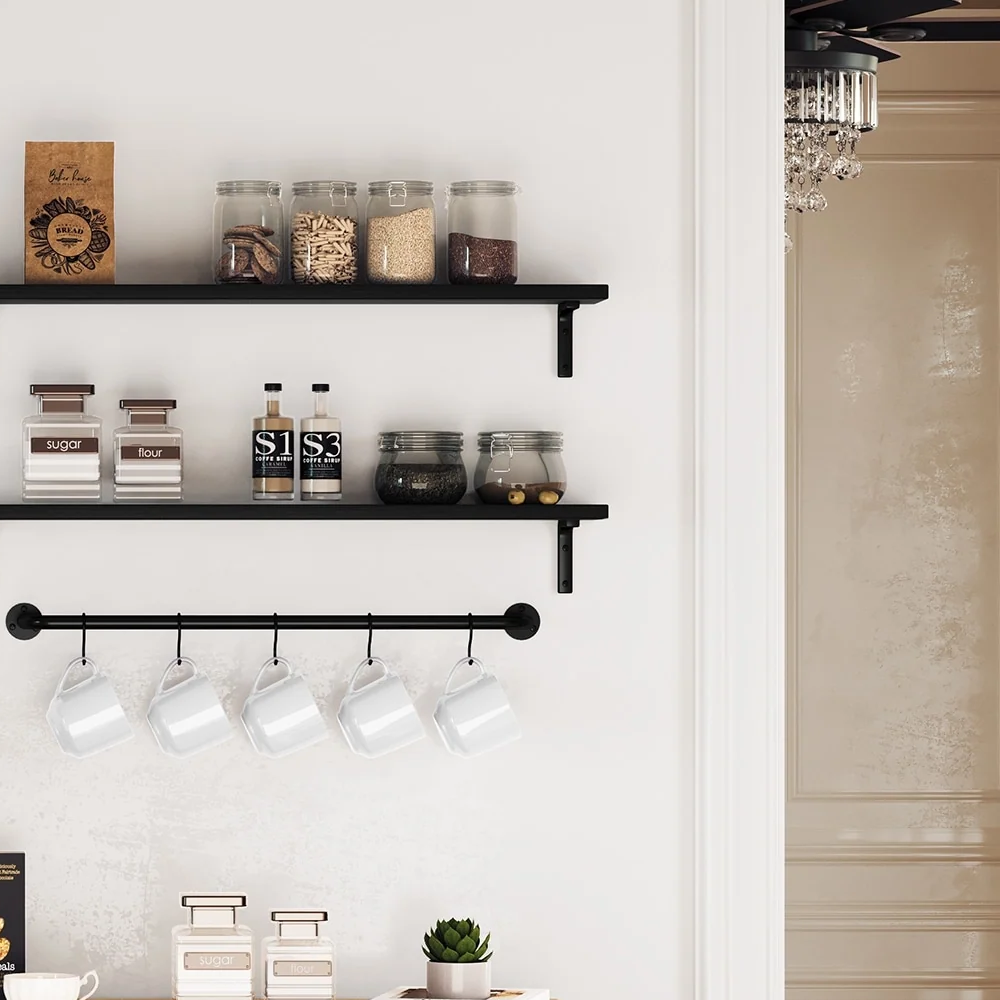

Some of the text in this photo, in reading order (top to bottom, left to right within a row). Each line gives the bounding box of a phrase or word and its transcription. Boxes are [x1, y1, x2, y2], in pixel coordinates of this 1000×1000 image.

[55, 226, 84, 235] BREAD
[46, 439, 82, 452] sugar
[255, 431, 293, 456] S1
[302, 433, 341, 458] S3
[138, 447, 163, 458] flour
[199, 954, 235, 967] sugar
[290, 963, 315, 974] flour
